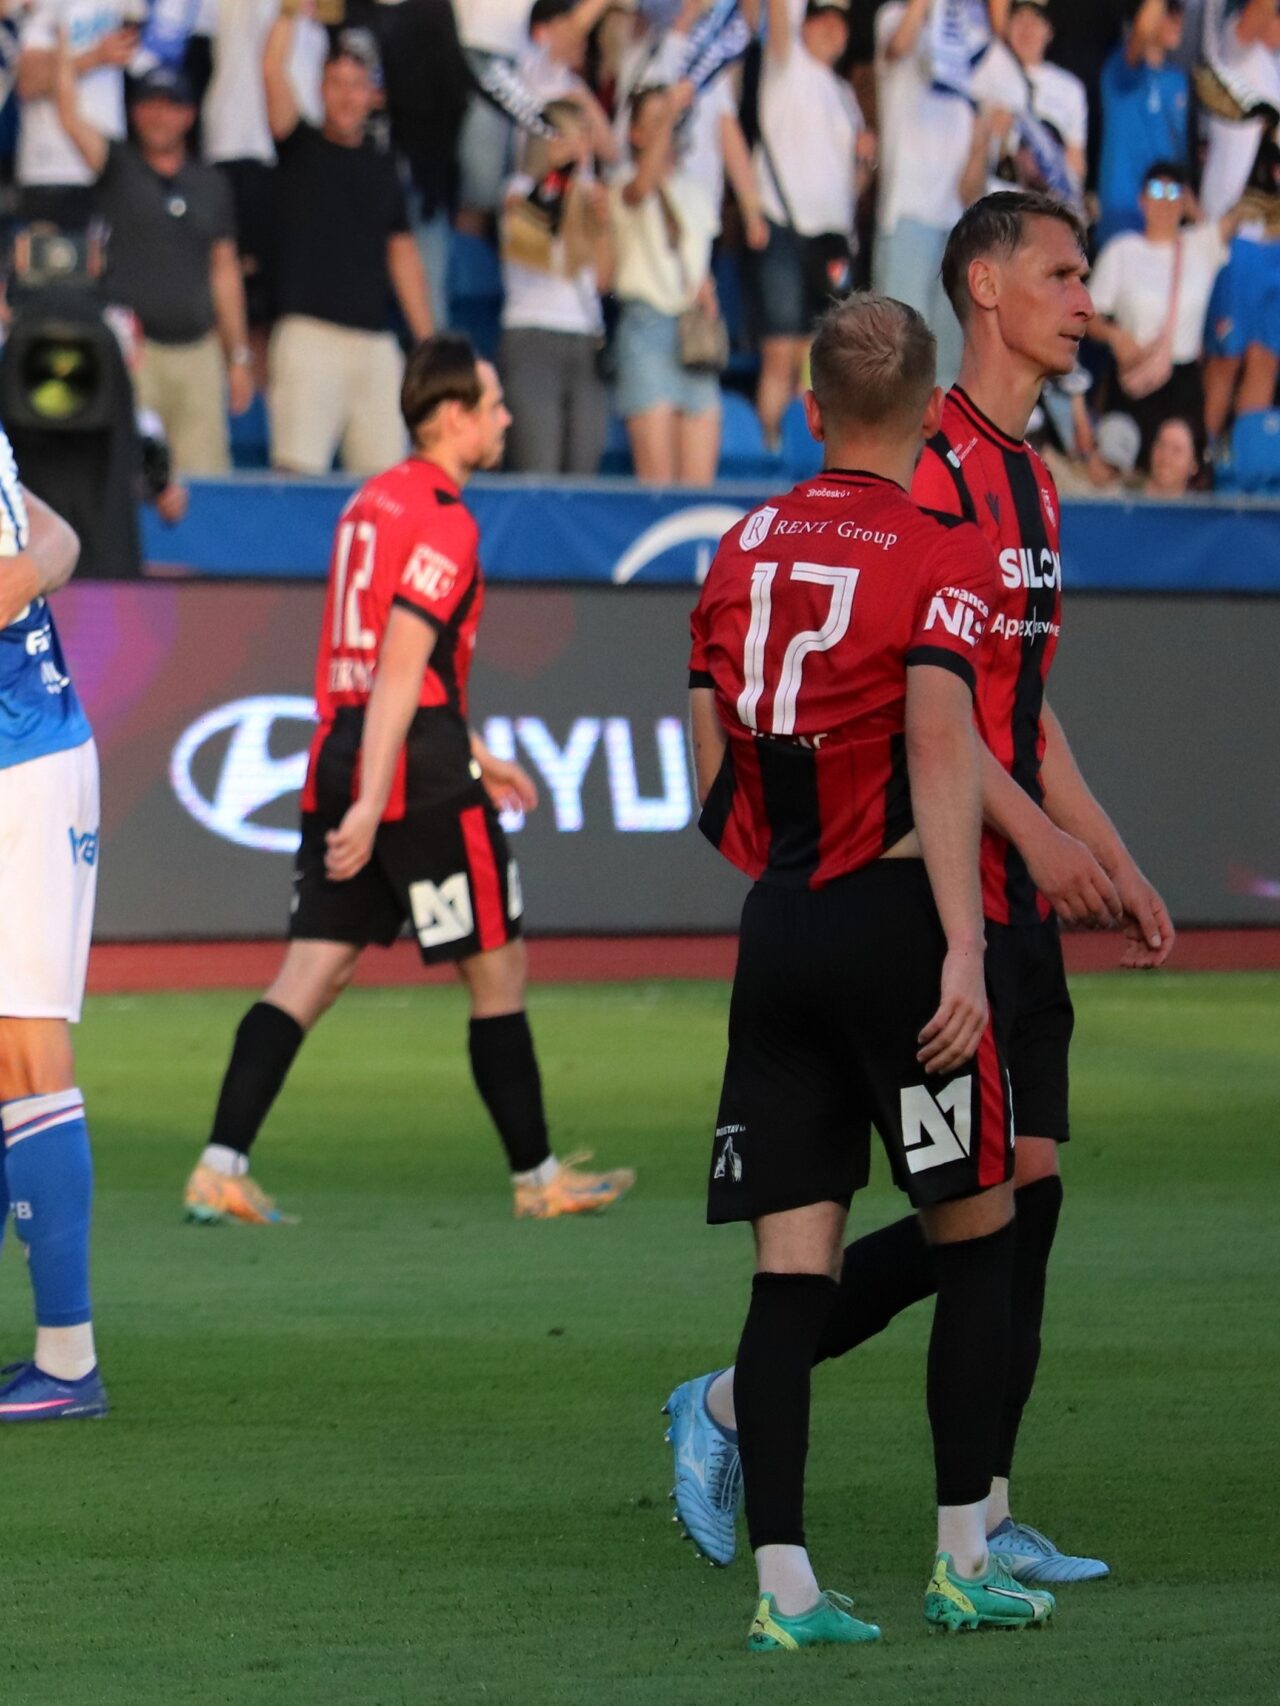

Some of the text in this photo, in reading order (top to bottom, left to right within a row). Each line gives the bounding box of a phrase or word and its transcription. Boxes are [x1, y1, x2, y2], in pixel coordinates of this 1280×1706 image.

[331, 520, 377, 650] 12
[773, 519, 898, 550] RENT Group
[736, 561, 861, 736] 17
